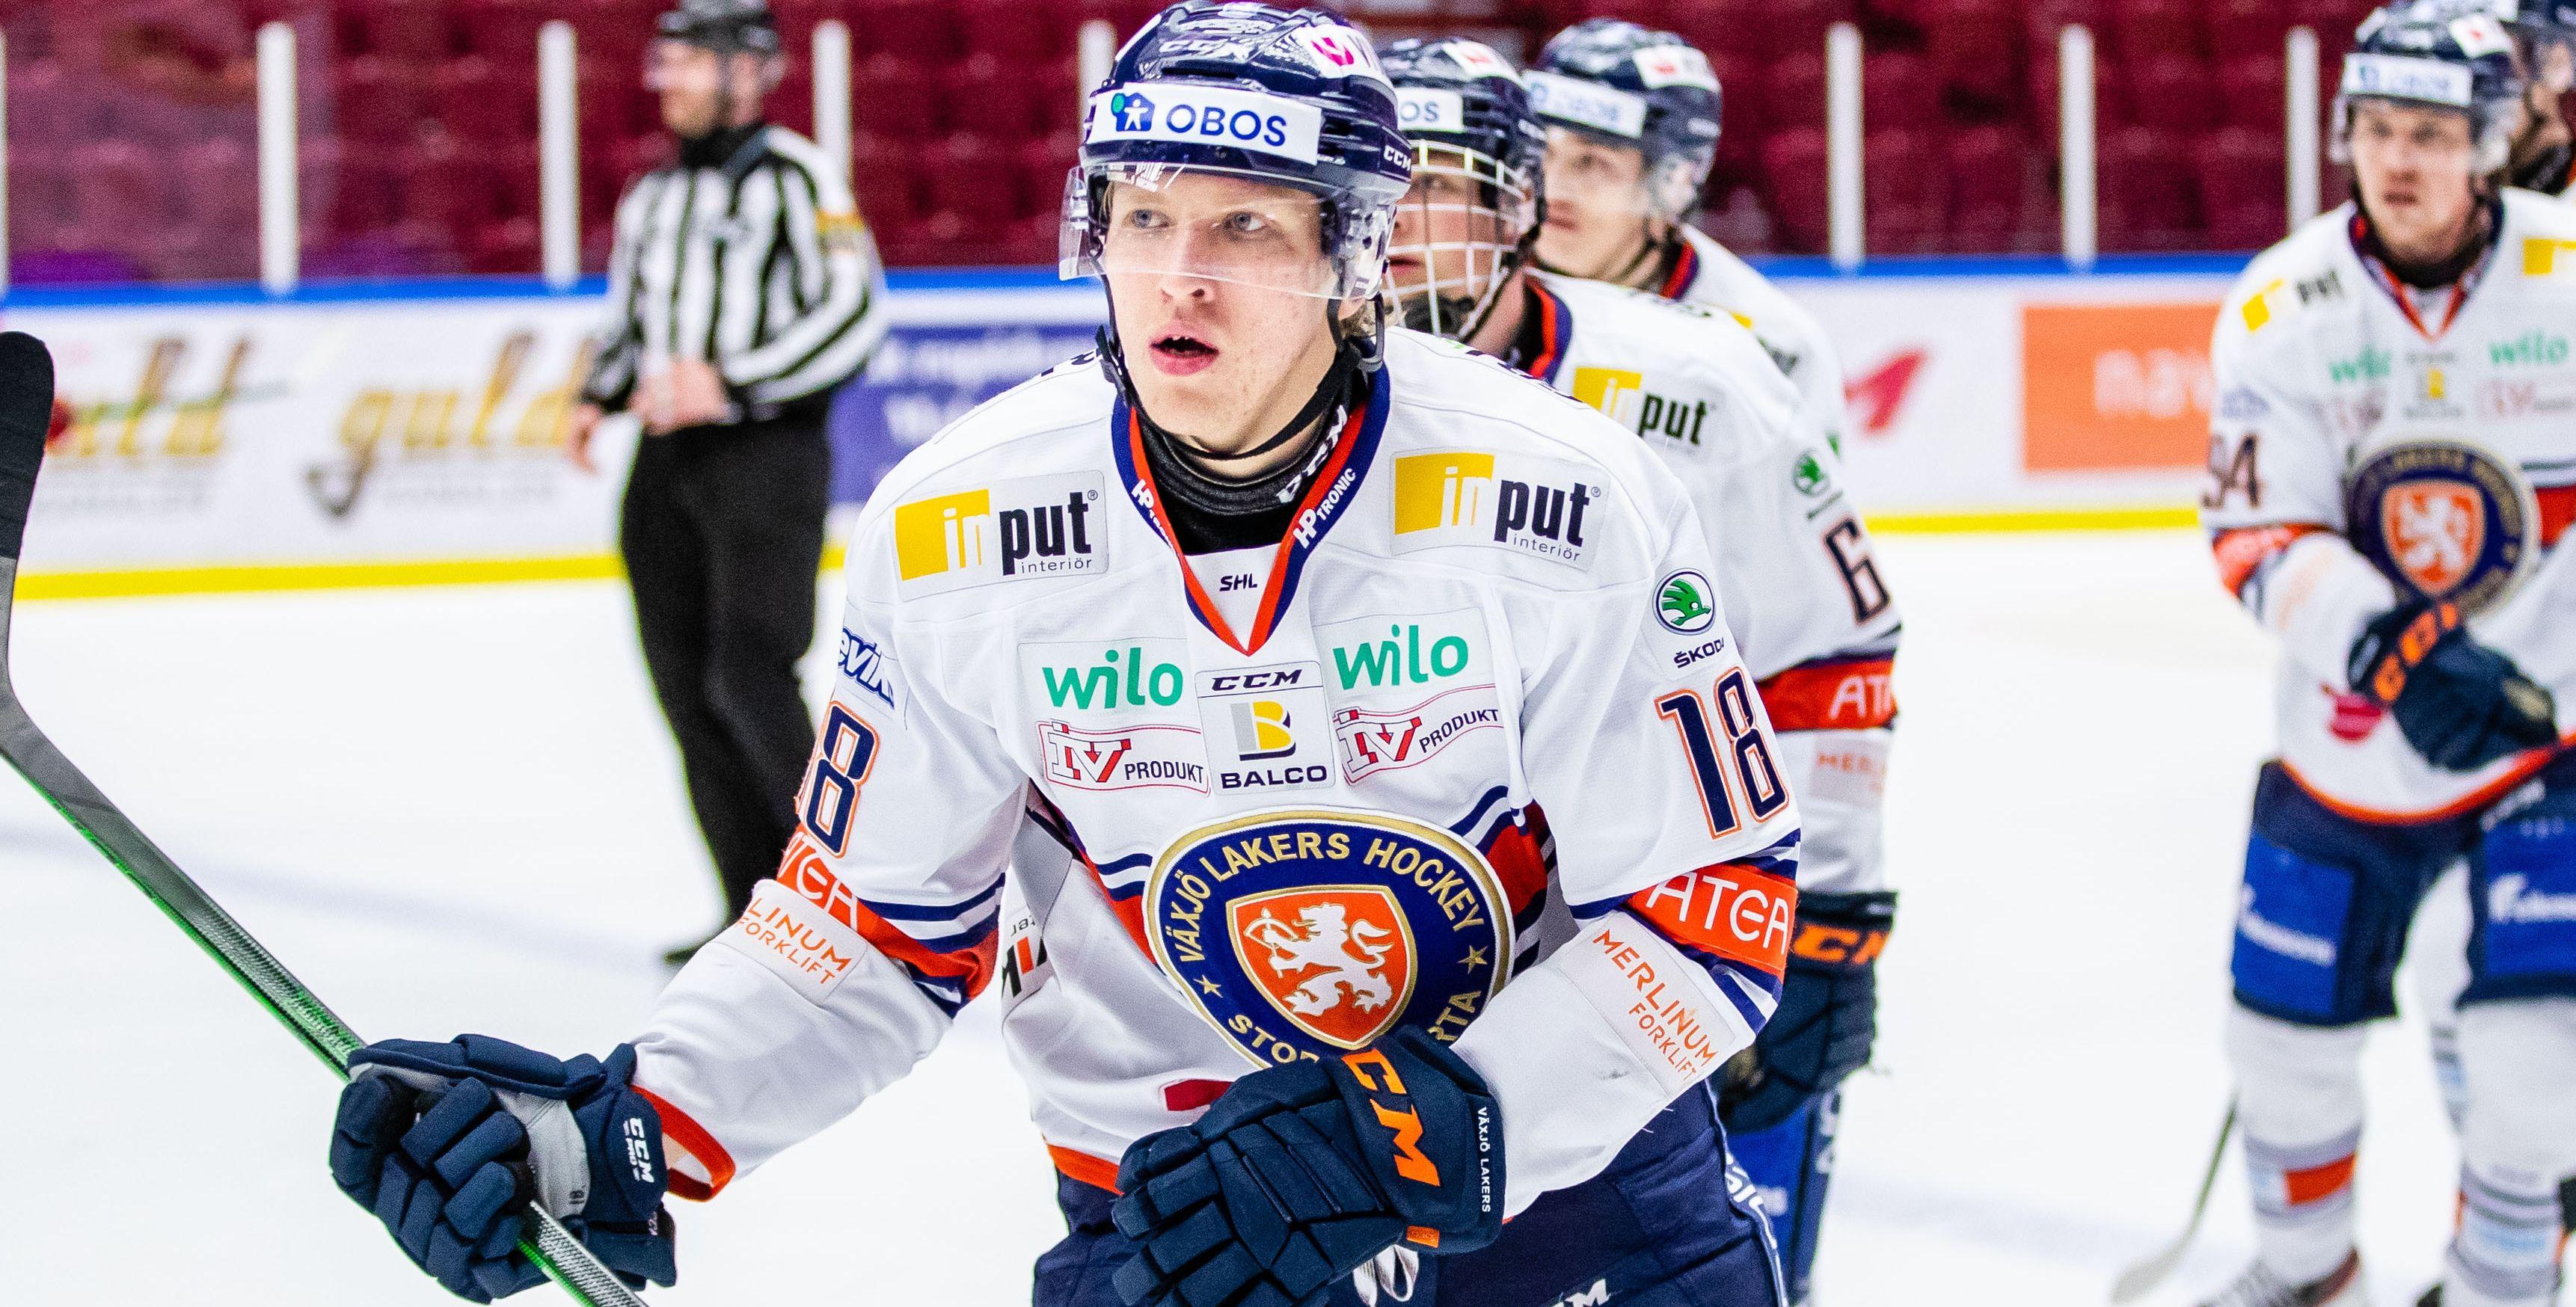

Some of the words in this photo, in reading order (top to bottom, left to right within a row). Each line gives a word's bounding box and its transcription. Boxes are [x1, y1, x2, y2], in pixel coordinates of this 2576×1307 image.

[1166, 103, 1287, 147] OBOS
[1398, 100, 1440, 123] OS
[1384, 144, 1411, 171] CCM
[942, 490, 1092, 576] input
[1440, 466, 1590, 548] input
[1020, 556, 1093, 575] interiör
[1512, 533, 1581, 562] interiör
[1219, 573, 1258, 592] SHL
[1042, 647, 1184, 710] wilo
[1211, 669, 1304, 692] CCM
[1332, 624, 1469, 691] wilo
[1673, 637, 1725, 669] ŠKOD
[1830, 675, 1892, 719] AT
[1419, 708, 1500, 754] PRODUKT
[1655, 665, 1790, 840] 18
[797, 700, 880, 859] 8
[1124, 760, 1206, 784] PRODUKT
[1221, 764, 1328, 790] BALCO
[1165, 869, 1212, 963] VÄXJÖ
[1200, 831, 1350, 882] LAKERS
[1363, 837, 1485, 932] HOCKEY
[1646, 870, 1789, 956] ATEA
[738, 917, 836, 985] FORKLIFT
[748, 897, 853, 972] LINUM
[1228, 1014, 1320, 1064] STO
[1426, 989, 1482, 1042] RTA
[1592, 929, 1719, 1068] MERLINUM
[1628, 1002, 1698, 1081] FORKLIFT
[1340, 1048, 1441, 1187] CM
[1477, 1106, 1491, 1152] VÄXJÖ
[629, 1117, 655, 1184] CCM
[1480, 1158, 1491, 1213] LAKERS
